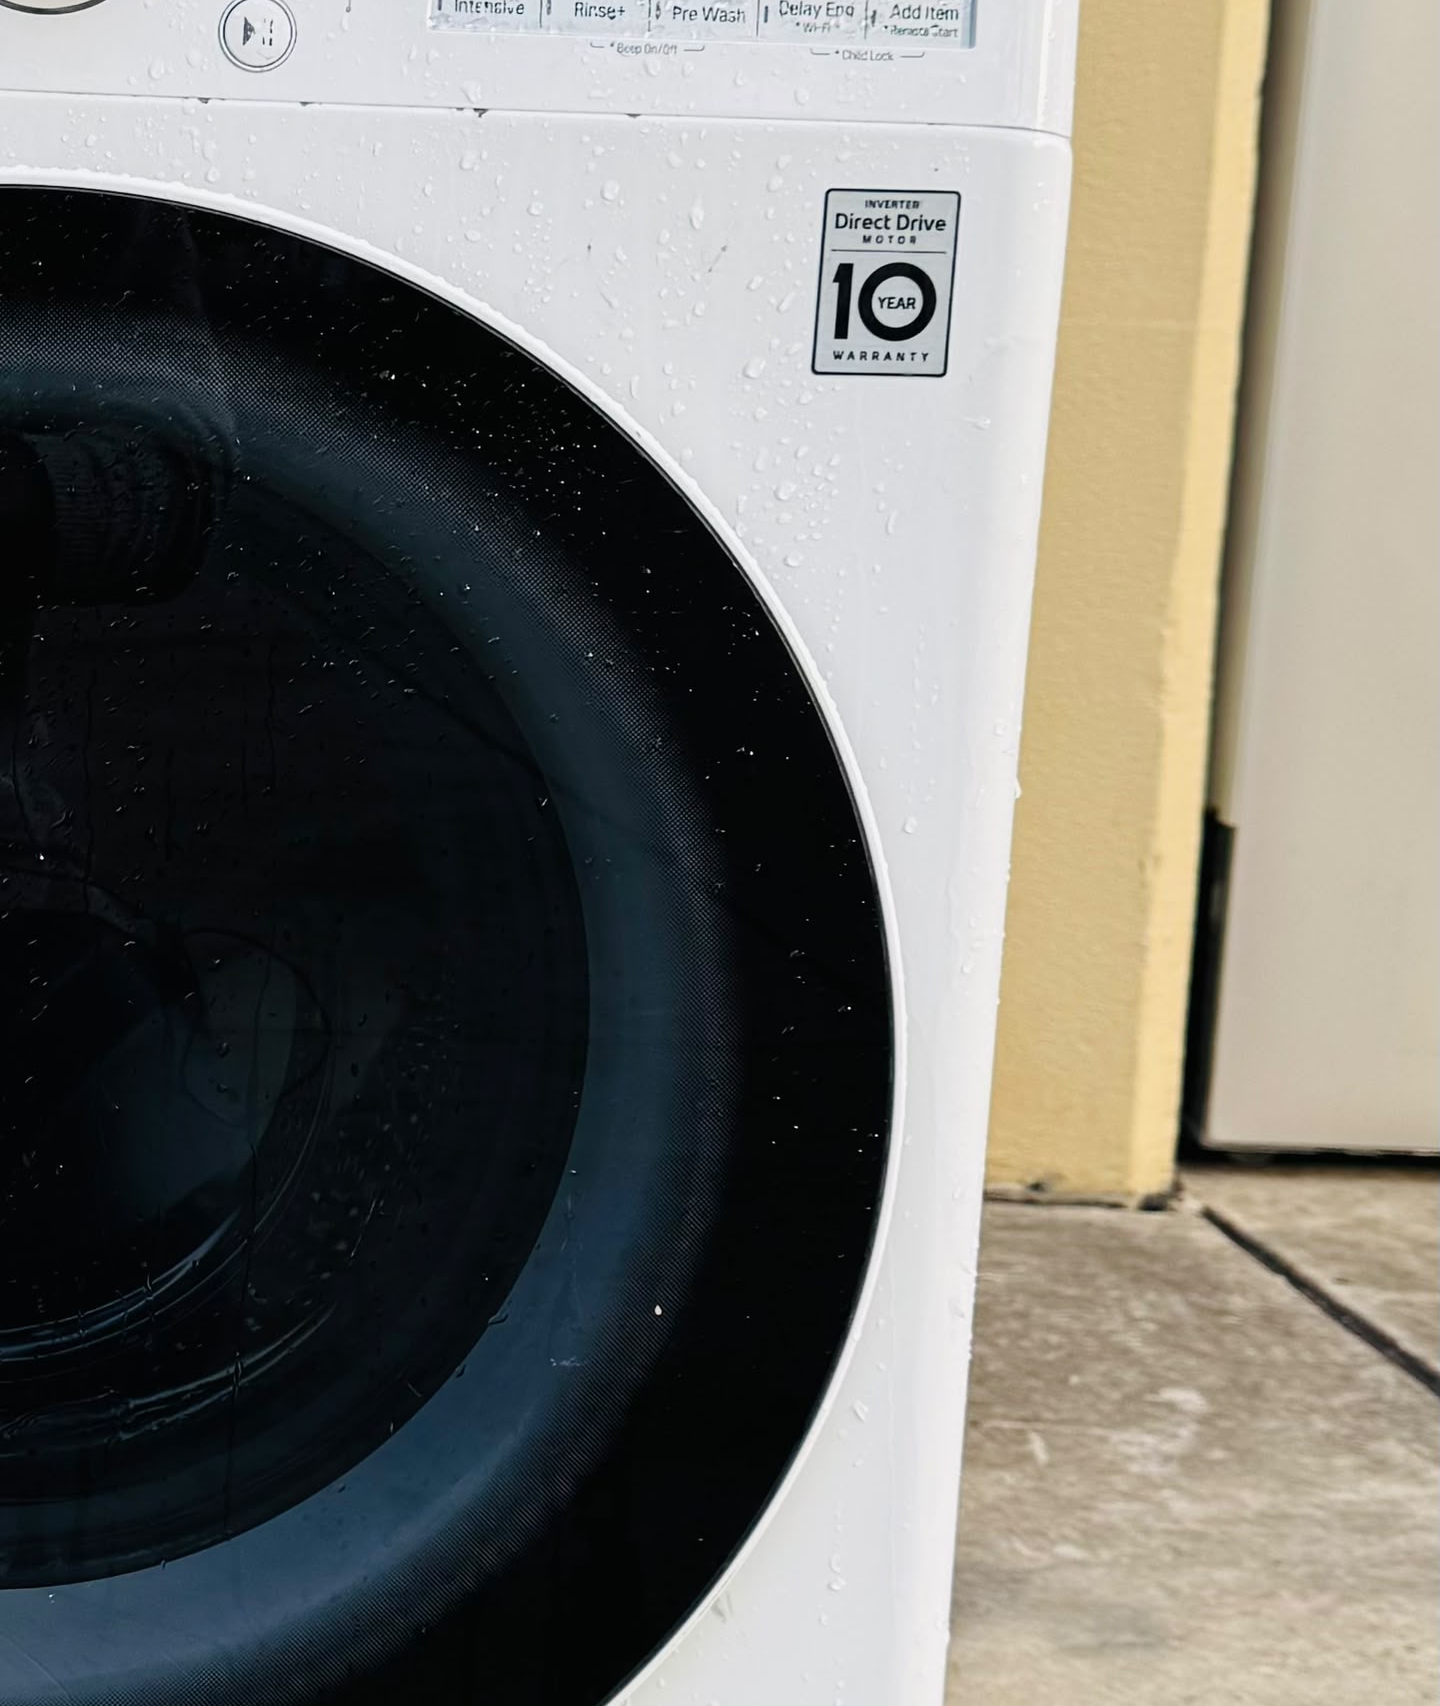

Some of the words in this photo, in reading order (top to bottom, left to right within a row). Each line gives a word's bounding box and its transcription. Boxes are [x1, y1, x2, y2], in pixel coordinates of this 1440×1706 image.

[671, 5, 698, 22] Pre
[701, 6, 746, 24] Wash
[888, 4, 921, 20] Add
[924, 4, 960, 22] Item
[864, 199, 921, 210] INVERTER
[834, 212, 891, 231] Direct
[896, 214, 947, 232] Drive
[862, 234, 917, 245] MOTOR
[832, 261, 937, 342] 10
[877, 296, 916, 309] YEAR
[832, 350, 930, 362] WARRANTY
